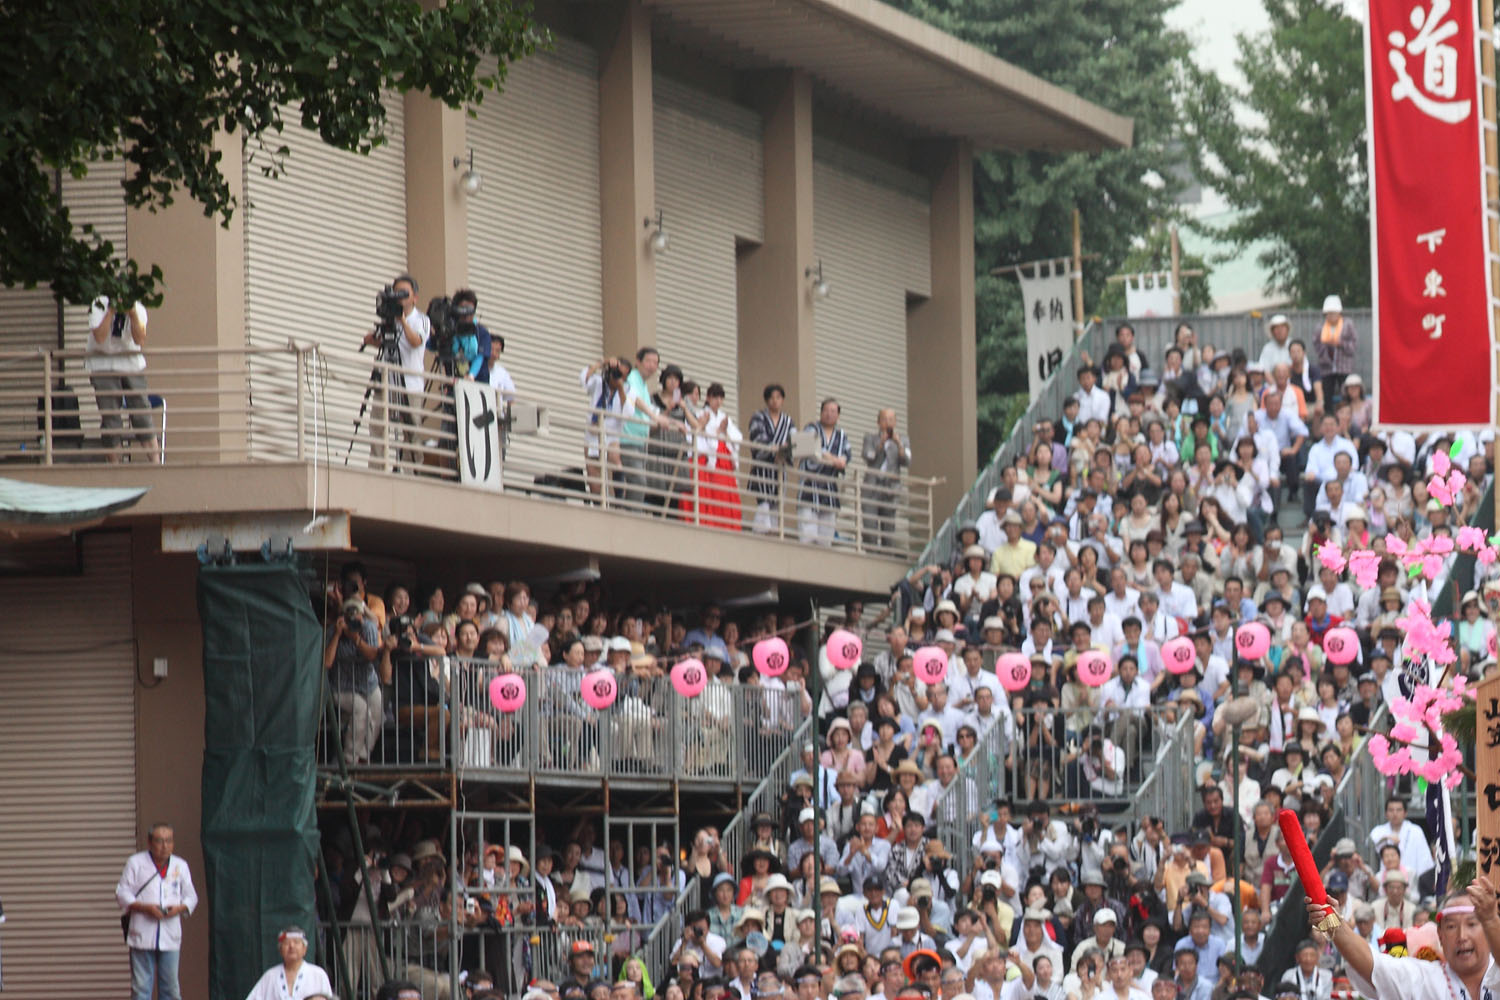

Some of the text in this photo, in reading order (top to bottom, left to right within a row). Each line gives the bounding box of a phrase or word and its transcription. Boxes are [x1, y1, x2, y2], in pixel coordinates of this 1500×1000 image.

[1388, 0, 1472, 124] 道
[1416, 228, 1447, 340] 下東町
[463, 388, 495, 482] け
